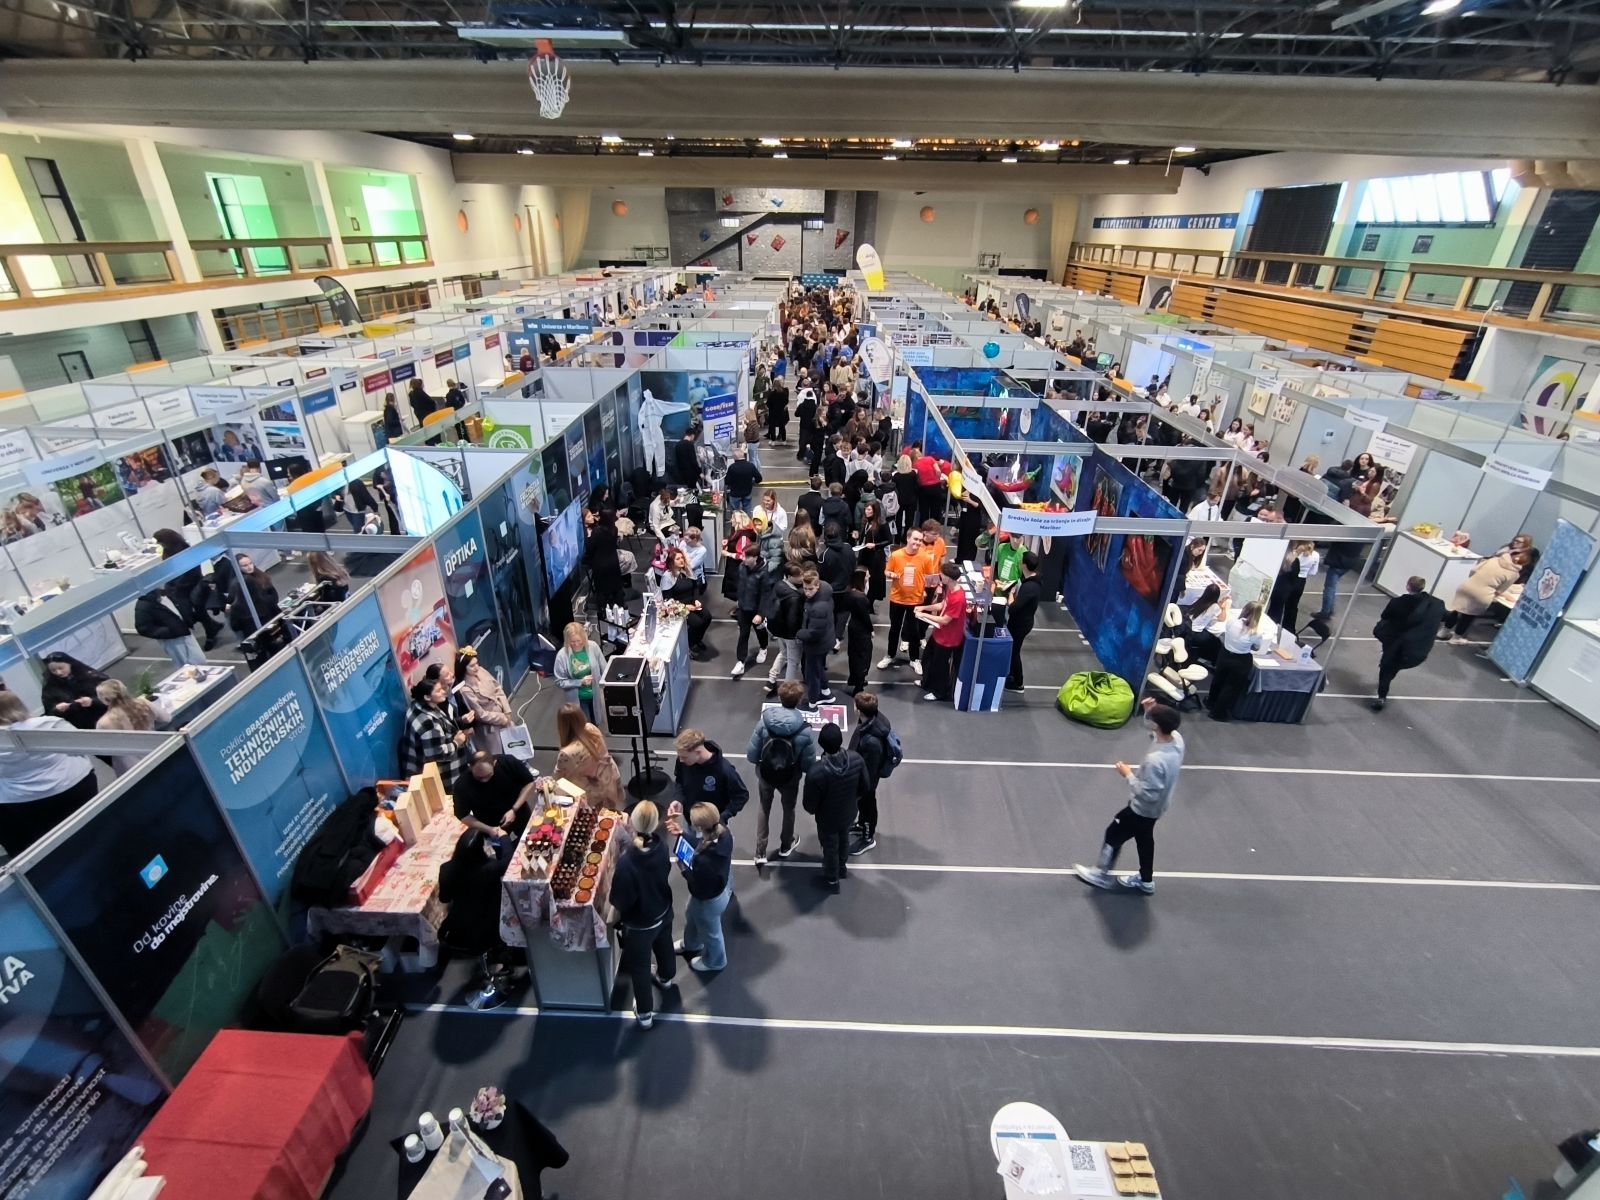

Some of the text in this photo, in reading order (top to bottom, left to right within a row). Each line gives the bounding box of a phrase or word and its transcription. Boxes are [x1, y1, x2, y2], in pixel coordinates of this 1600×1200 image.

[1148, 217, 1180, 228] ŠPORTNI
[1188, 218, 1220, 228] CENTER
[1008, 514, 1029, 522] Srednja
[445, 537, 477, 576] OPTIKA
[324, 630, 376, 684] PREVOZNIŠTVU
[327, 639, 380, 692] IN AVTO STROKI
[219, 731, 245, 758] Poklici
[224, 699, 300, 771] TEHNIČNIH IN
[230, 710, 304, 784] INOVACIJSKIH
[288, 723, 306, 741] strok
[133, 894, 187, 953] Od kovine
[151, 874, 218, 950] do mojstrovine.
[15, 1075, 70, 1134] spretnosti
[28, 1159, 42, 1175] do
[44, 1091, 100, 1156] oblikovanja
[33, 1118, 47, 1134] do
[49, 1076, 84, 1116] narave
[33, 1140, 44, 1152] in
[46, 1068, 106, 1137] inovativnost
